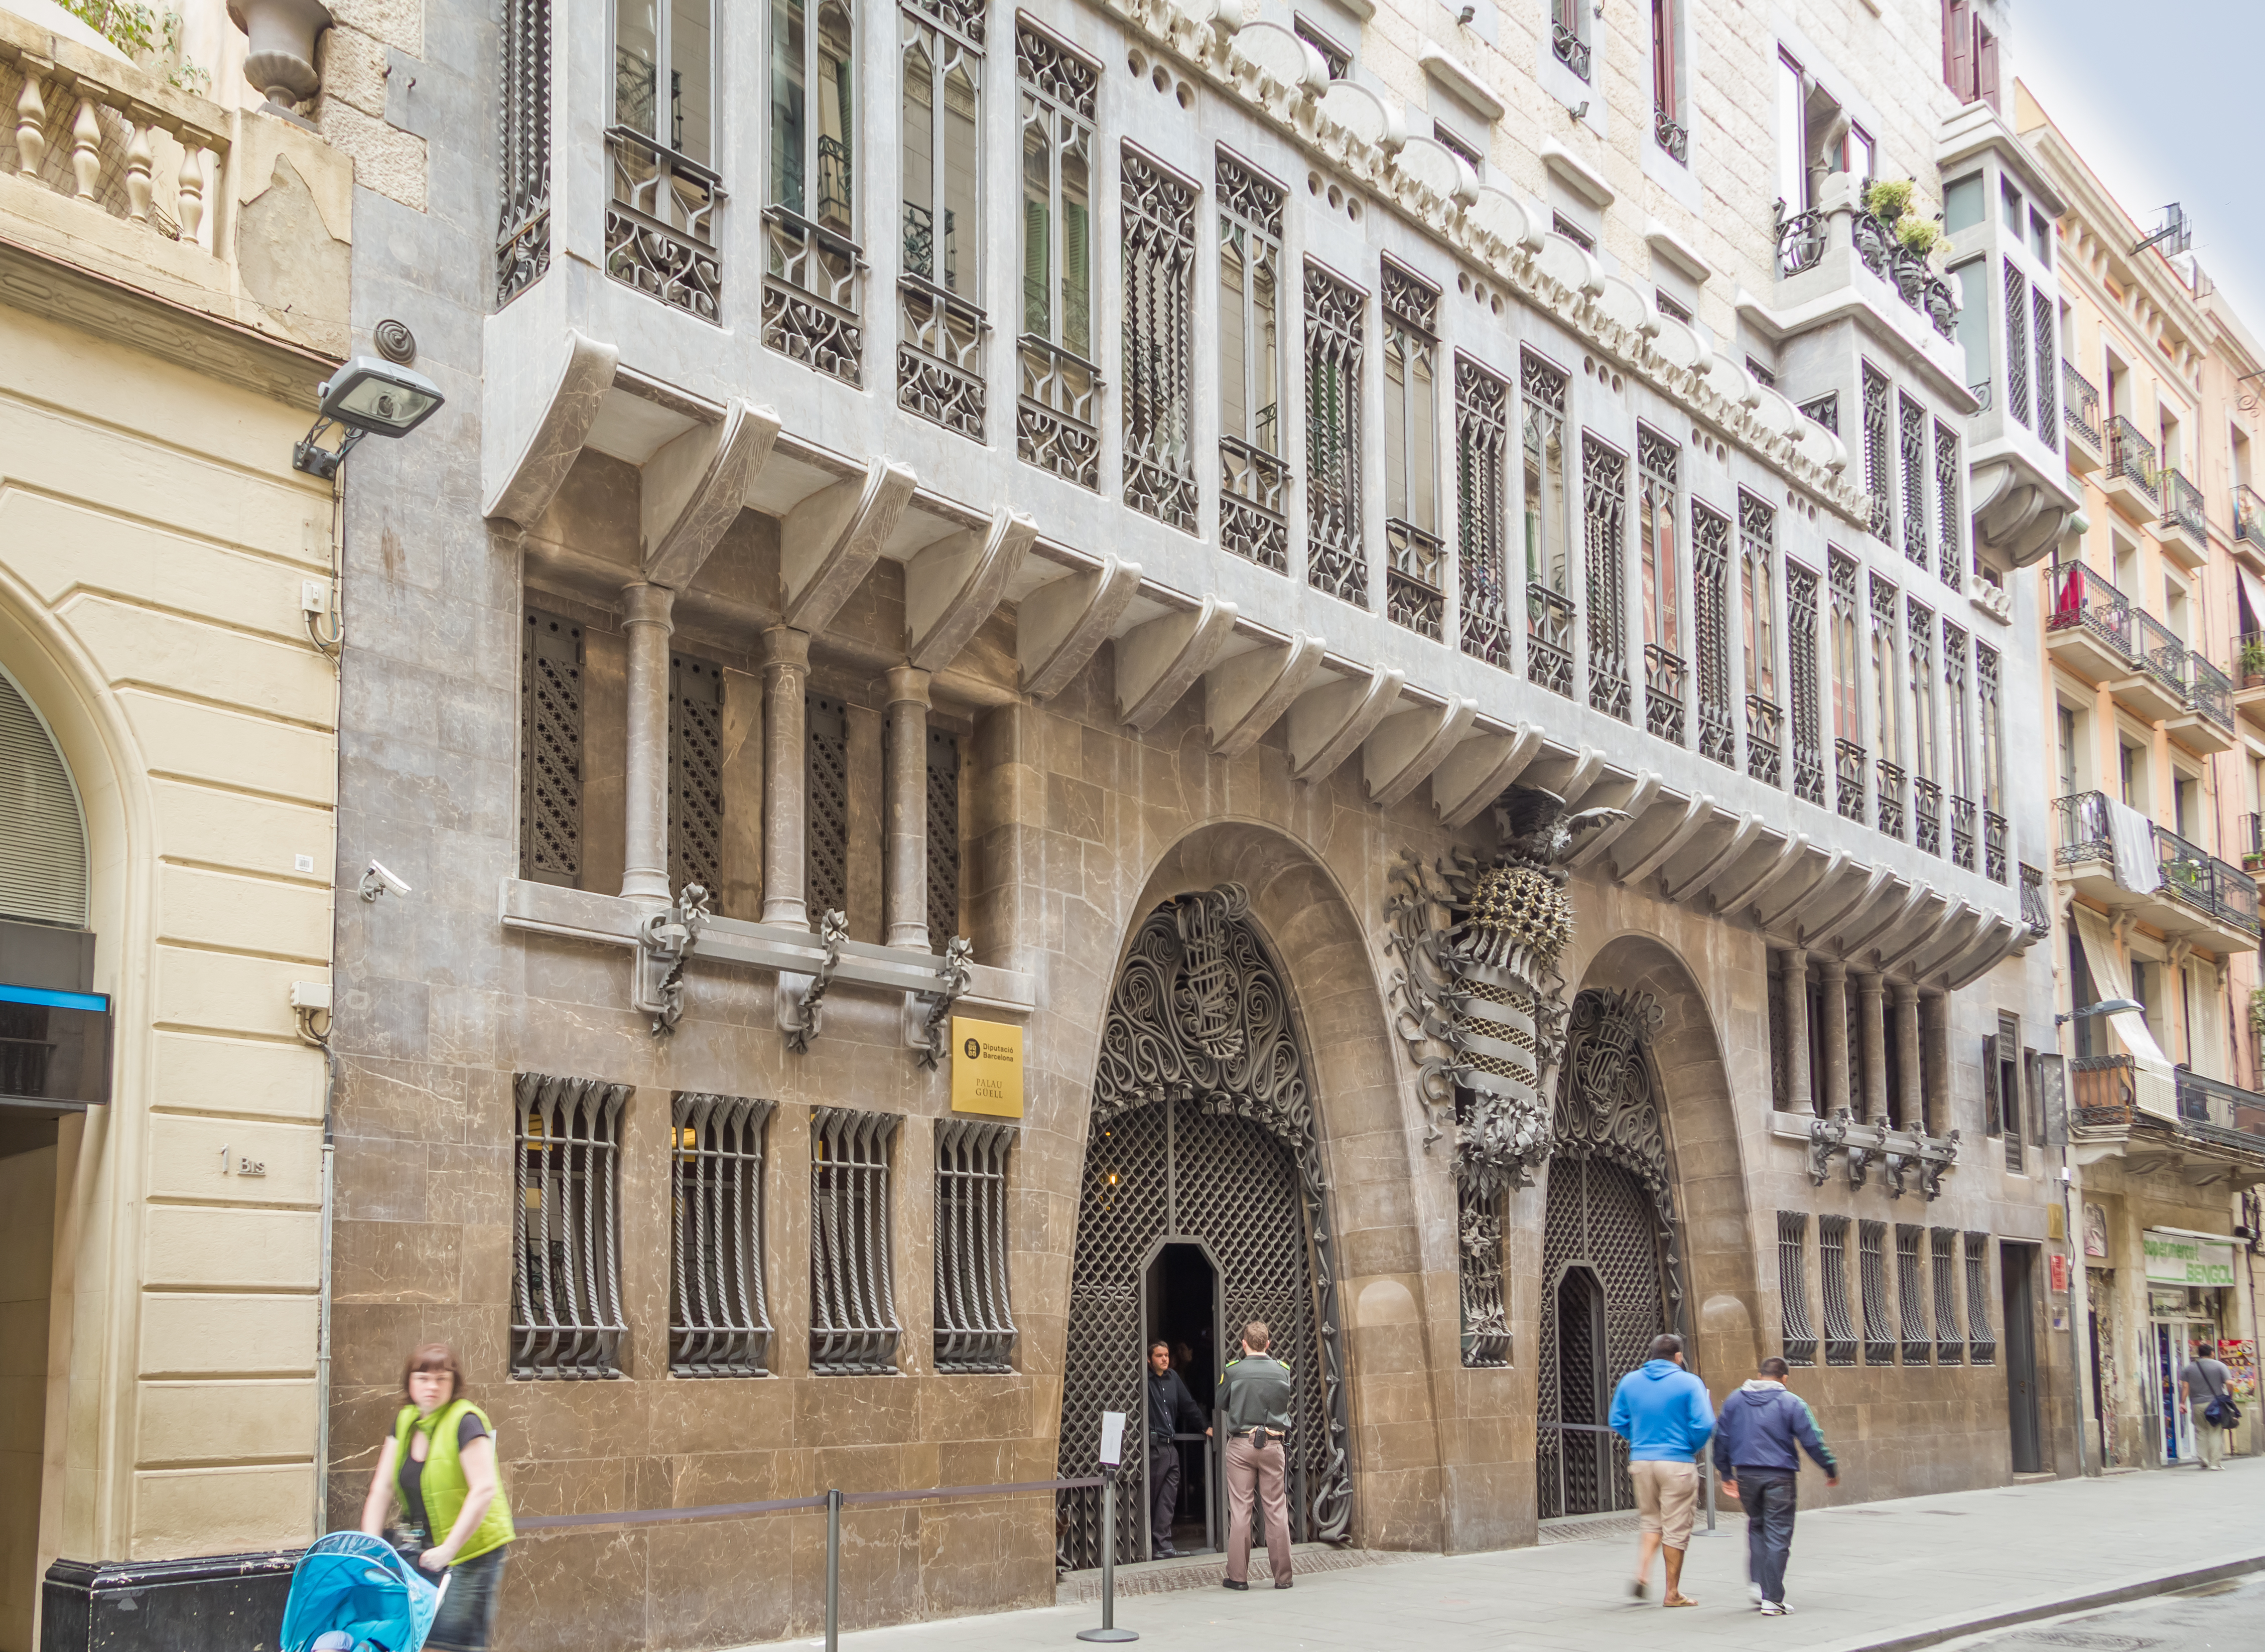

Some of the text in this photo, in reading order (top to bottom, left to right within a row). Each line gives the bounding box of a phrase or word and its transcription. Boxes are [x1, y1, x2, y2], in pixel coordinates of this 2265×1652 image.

[983, 1043, 1013, 1054] Diputació
[983, 1051, 1013, 1062] Barcelona
[976, 1078, 1002, 1089] PALAU
[975, 1087, 1003, 1099] GÜELL
[220, 1143, 229, 1173] 1
[2186, 1263, 2234, 1284] BENGOL
